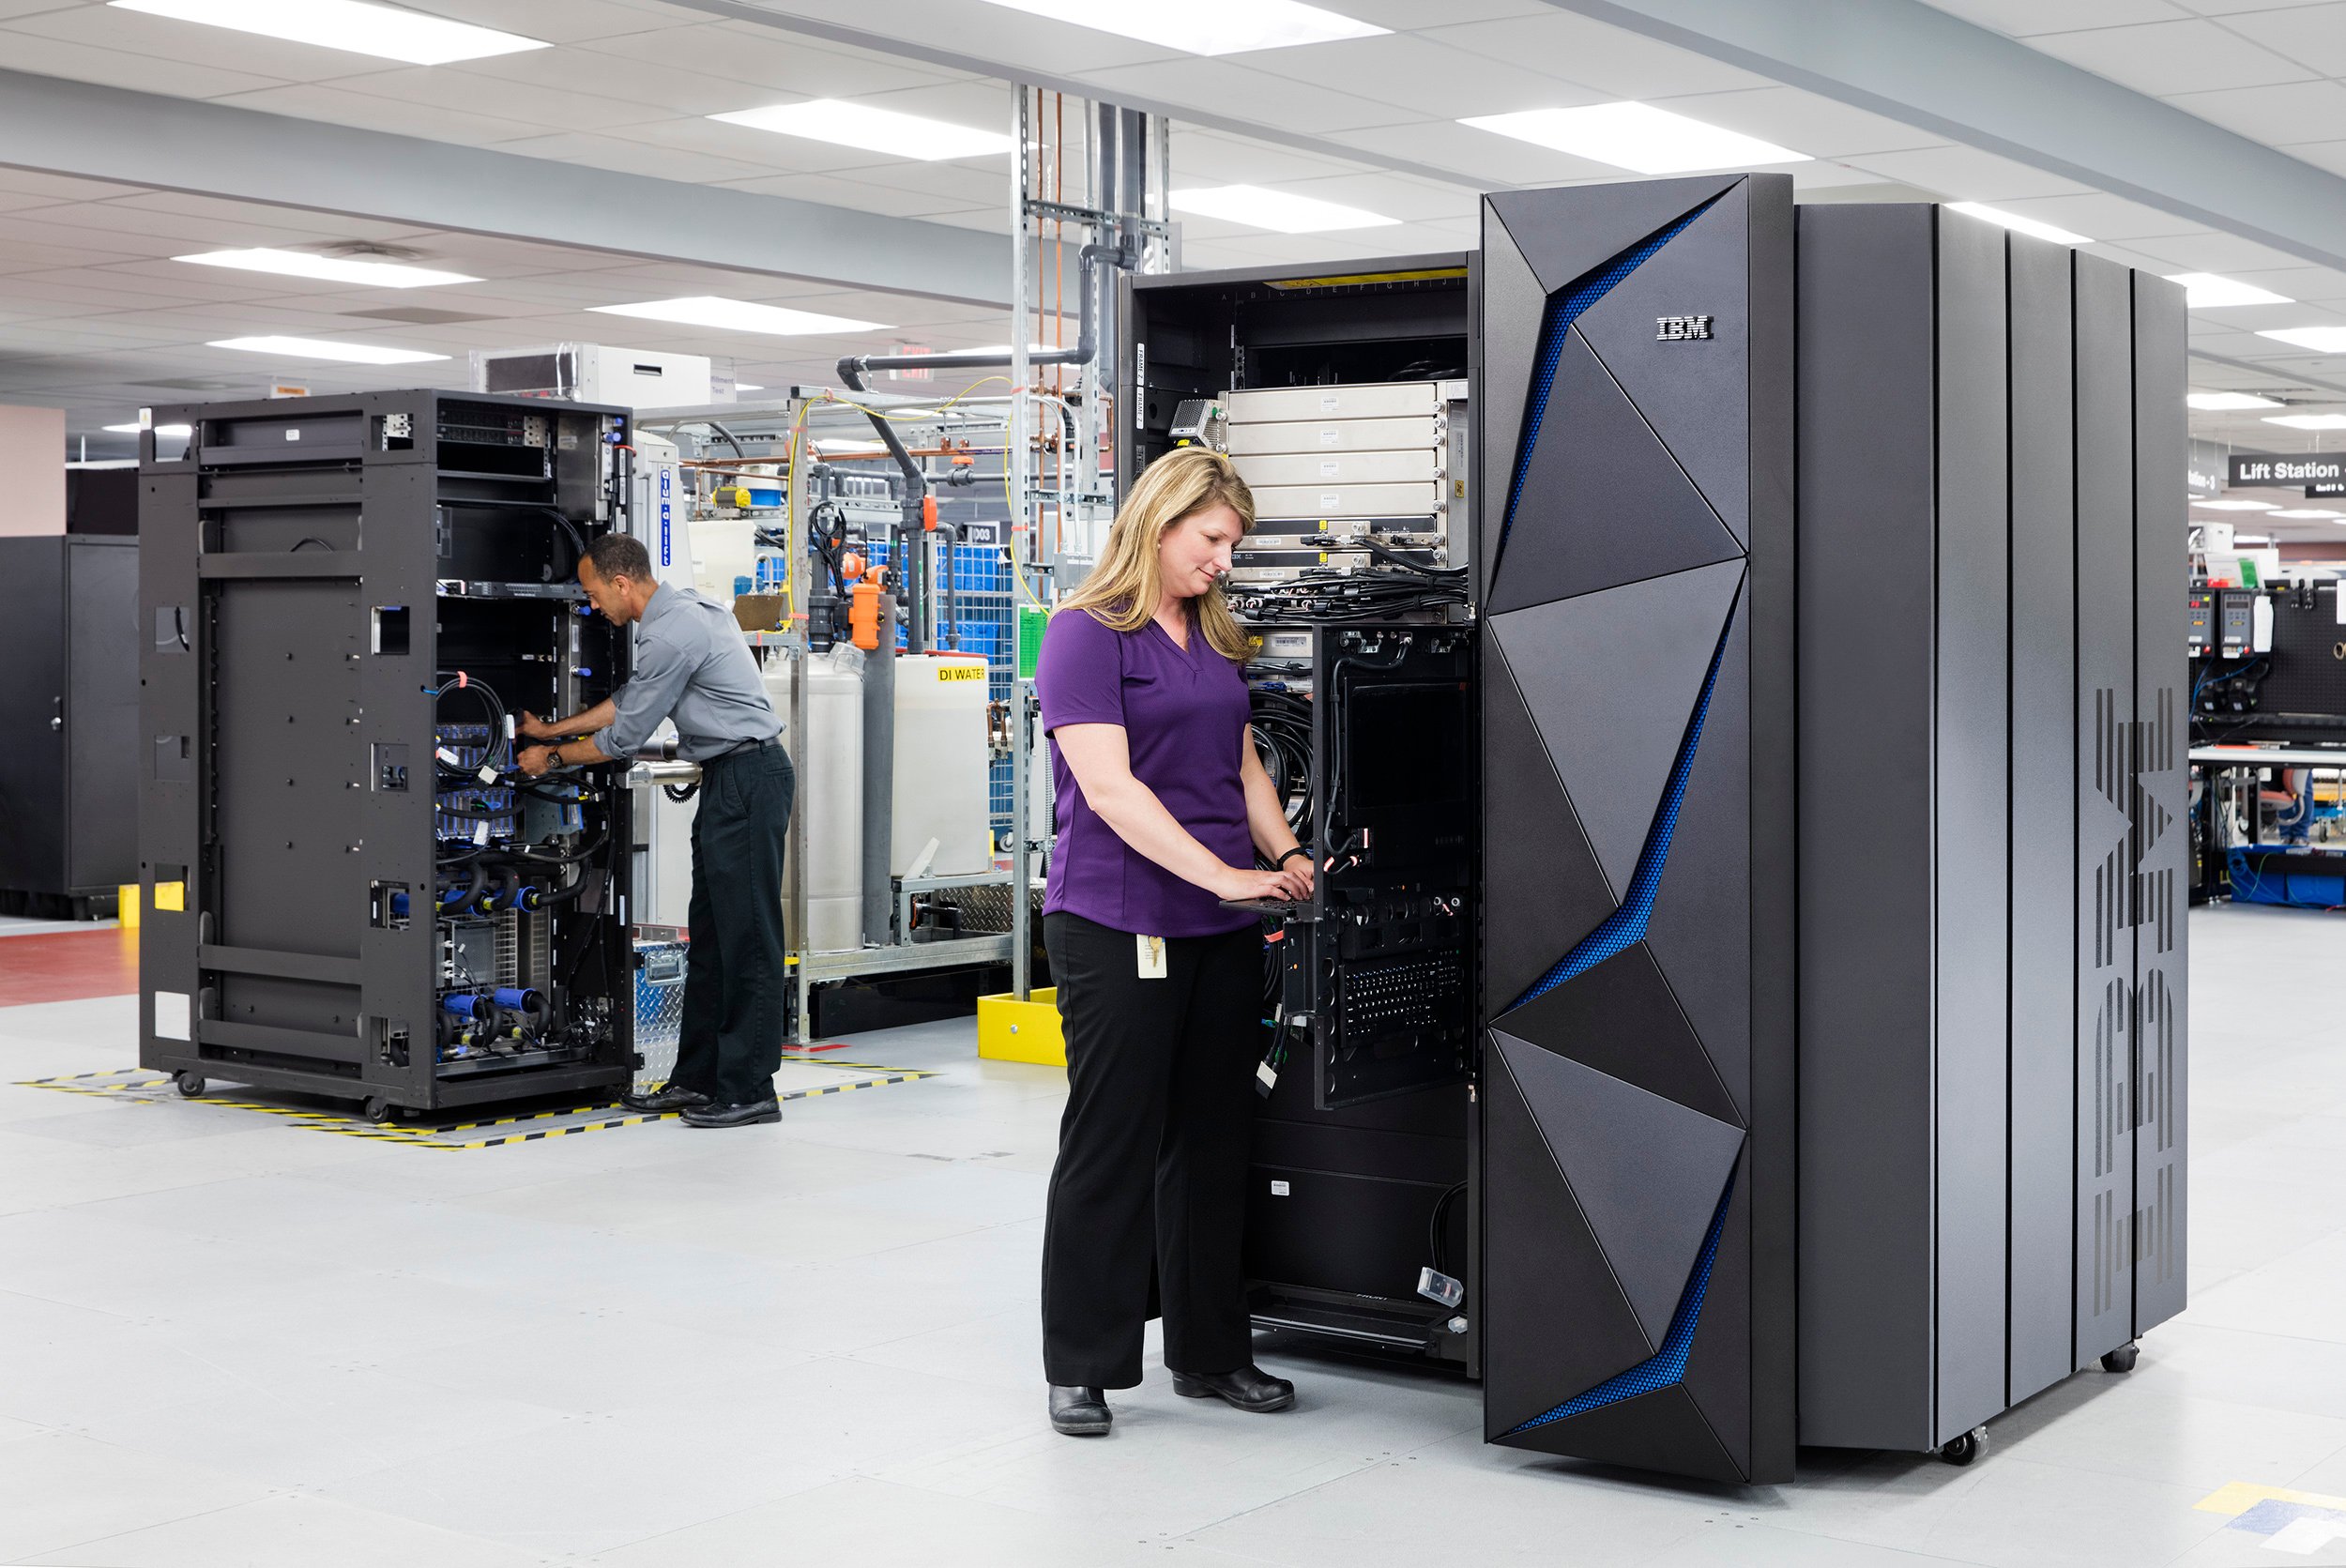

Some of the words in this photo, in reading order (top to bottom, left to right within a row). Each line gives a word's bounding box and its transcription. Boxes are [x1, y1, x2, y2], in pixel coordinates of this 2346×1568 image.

[1656, 315, 1712, 340] IBM
[2240, 463, 2270, 480] Lift
[2274, 461, 2339, 480] Station
[940, 669, 952, 680] DI
[954, 668, 985, 680] WATER
